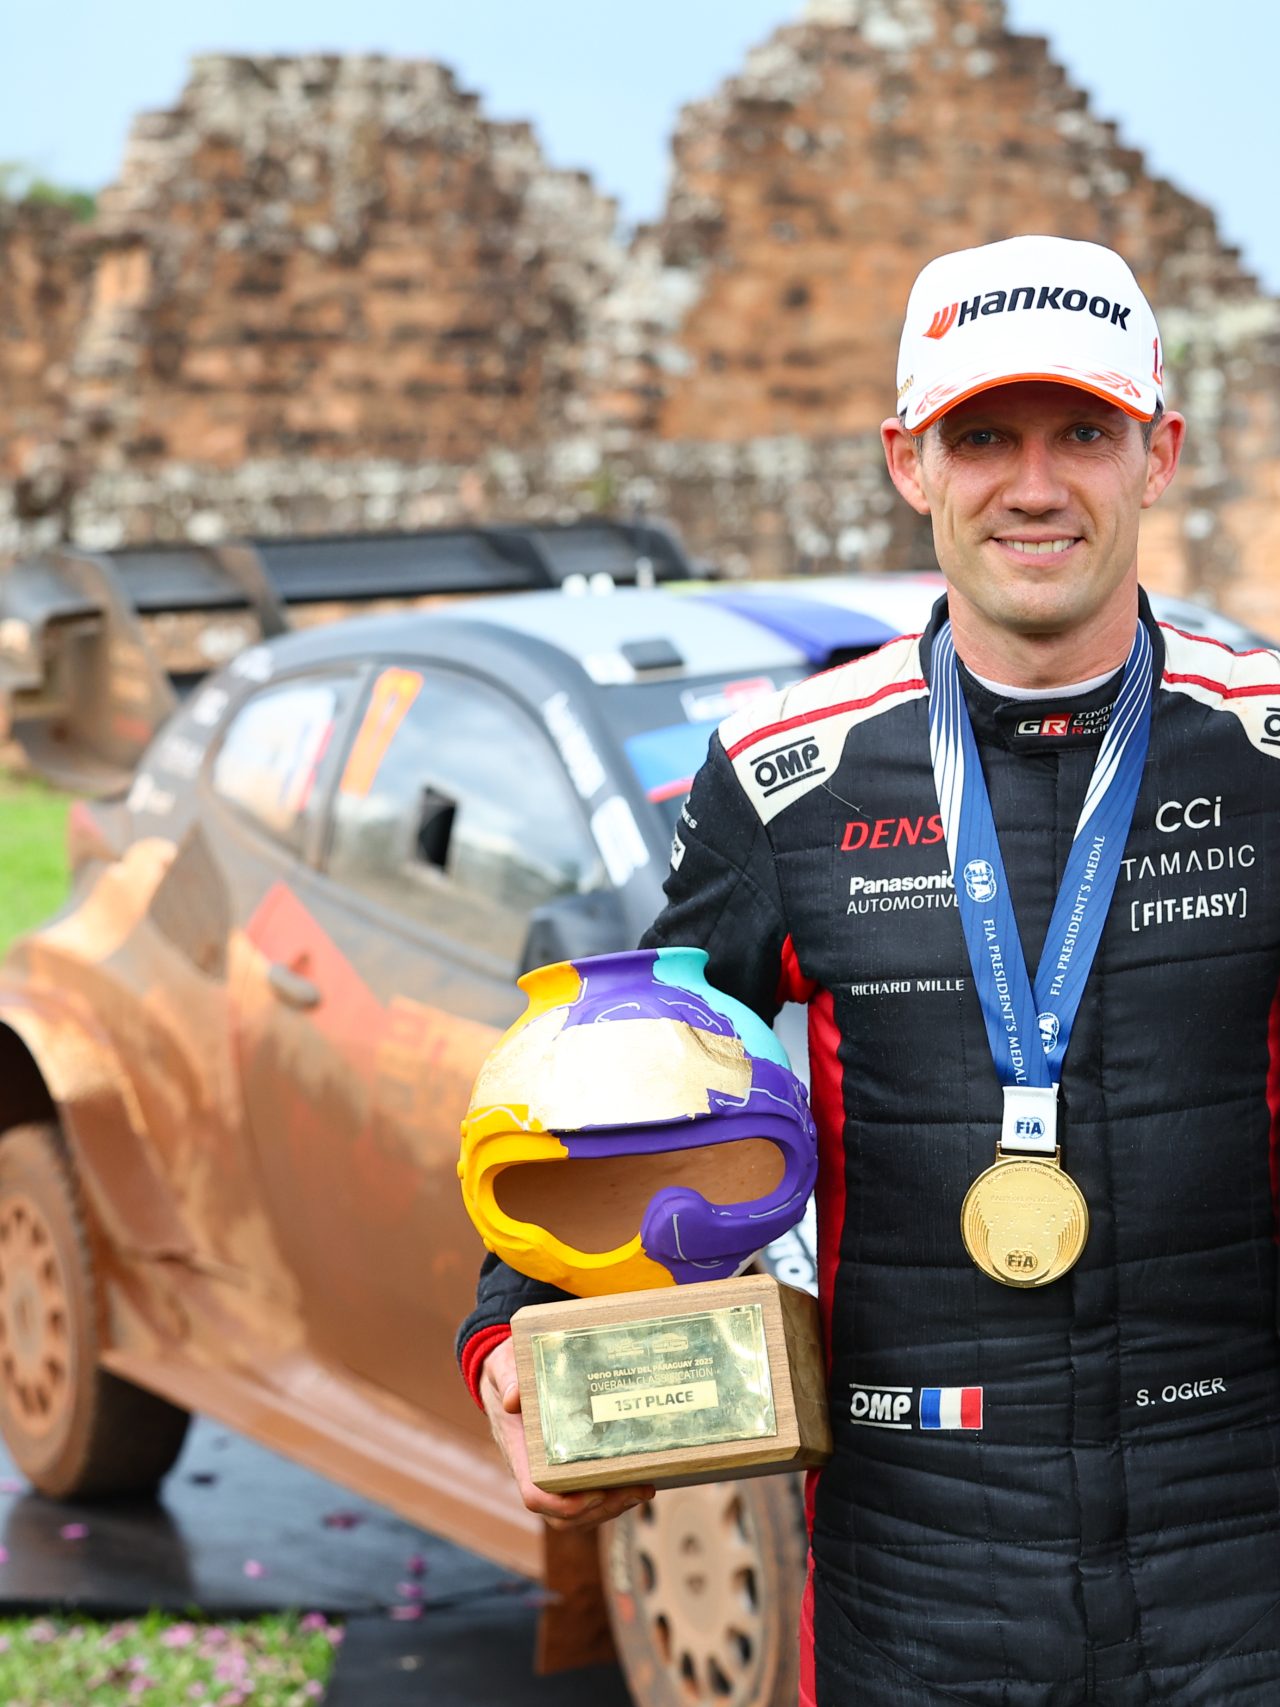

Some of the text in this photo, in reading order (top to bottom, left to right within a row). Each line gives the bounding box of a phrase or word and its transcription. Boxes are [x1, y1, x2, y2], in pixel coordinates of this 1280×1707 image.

[1073, 714, 1110, 726] GAZO
[1076, 703, 1115, 719] TOYOT
[1016, 718, 1068, 736] GR
[1071, 723, 1108, 735] Racin
[753, 741, 821, 790] OMP
[841, 814, 945, 851] DENS
[1121, 845, 1256, 881] TAMADIC
[1050, 836, 1106, 996] FIA PRESIDENT'S MEDAL
[851, 978, 965, 996] RICHARD MILLE
[983, 918, 1028, 1083] FIA PRESIDENT'S MEDAL
[613, 1367, 637, 1377] RALLY
[637, 1365, 652, 1374] DEL
[653, 1359, 693, 1372] PARAGUAY
[590, 1378, 632, 1392] OVERALL
[1136, 1377, 1228, 1407] S. OGIER
[615, 1390, 695, 1412] 1ST PLACE
[849, 1389, 912, 1423] OMP
